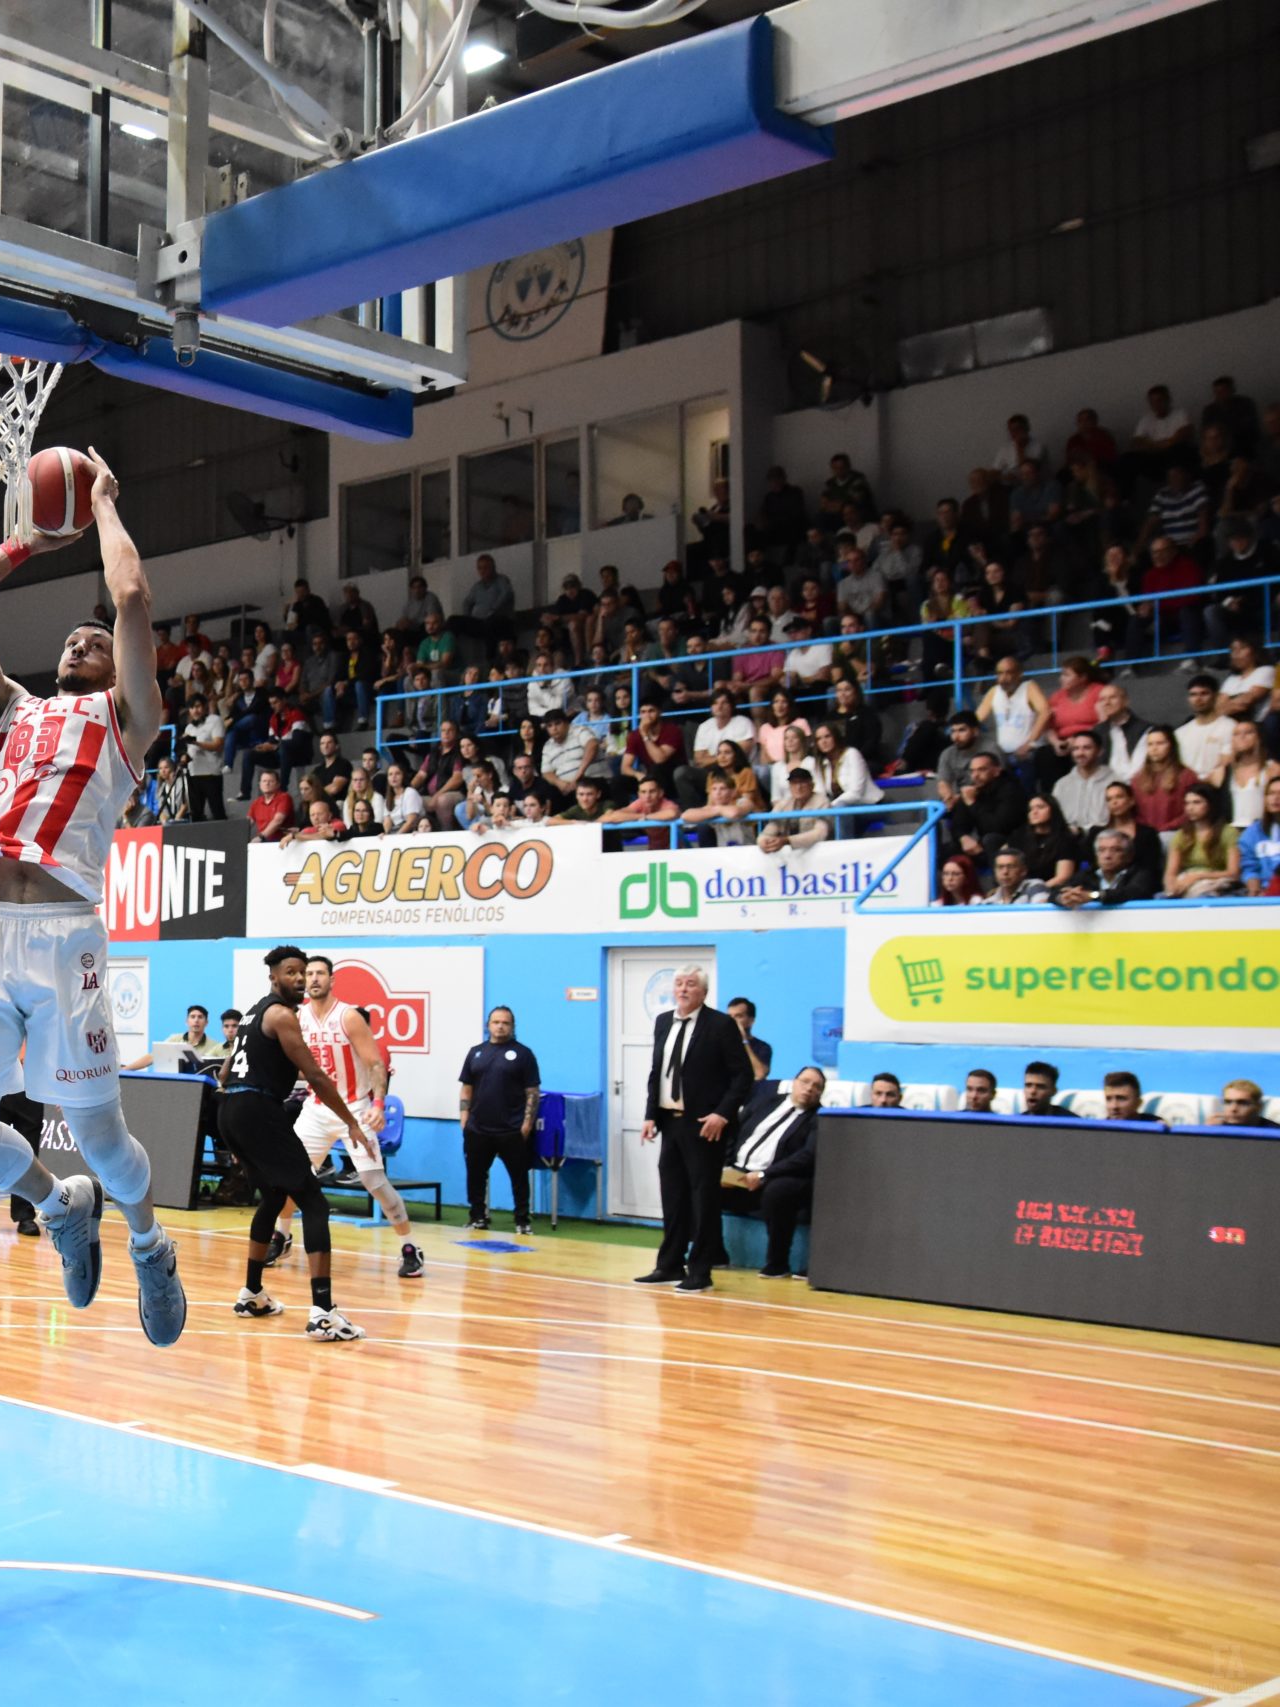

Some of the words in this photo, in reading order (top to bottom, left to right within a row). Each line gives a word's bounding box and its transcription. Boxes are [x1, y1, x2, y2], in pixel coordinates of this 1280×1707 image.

[9, 720, 60, 766] 83
[95, 840, 226, 931] MONTE
[283, 839, 554, 905] AGUERCO
[705, 868, 767, 899] don
[780, 860, 898, 896] basilio
[320, 909, 421, 926] COMPENSADOS
[425, 903, 505, 924] FENÓLICOS
[965, 958, 1280, 999] superelcondo
[56, 1065, 112, 1084] QUORUM
